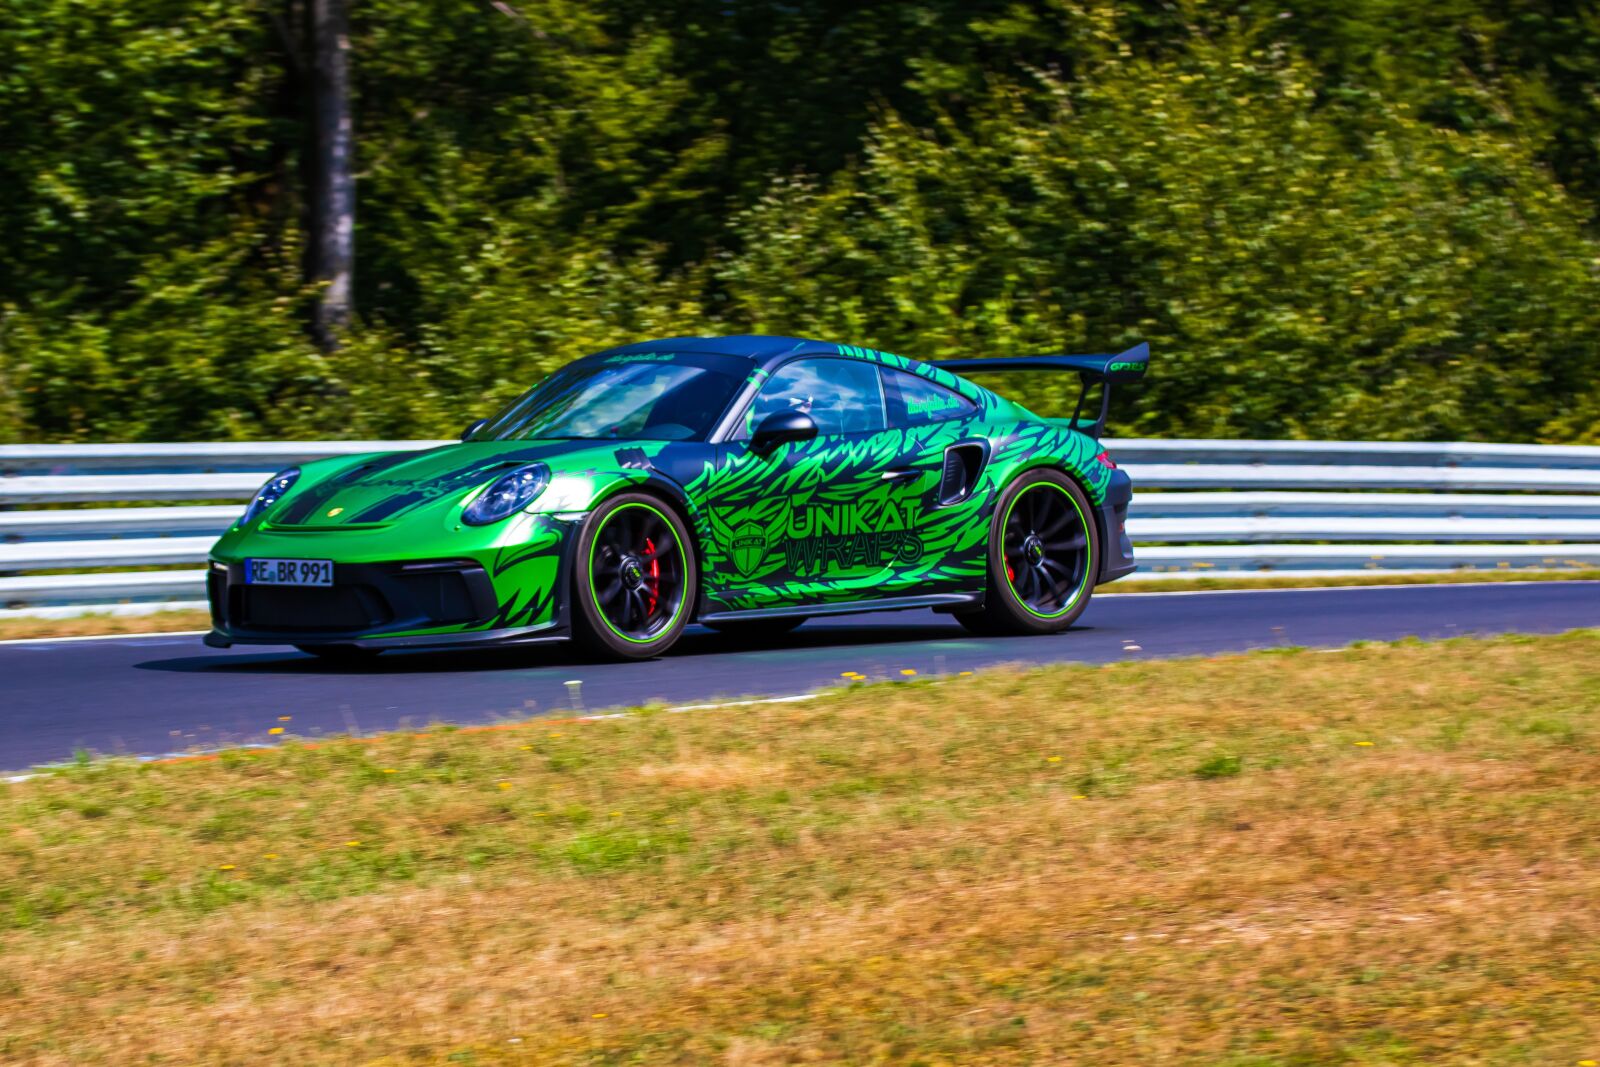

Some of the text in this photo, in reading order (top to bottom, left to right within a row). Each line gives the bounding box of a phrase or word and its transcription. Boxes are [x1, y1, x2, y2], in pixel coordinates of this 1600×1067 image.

[787, 498, 922, 539] UNIKAT
[252, 561, 330, 583] RE BR 991
[785, 531, 924, 573] WRAPS
